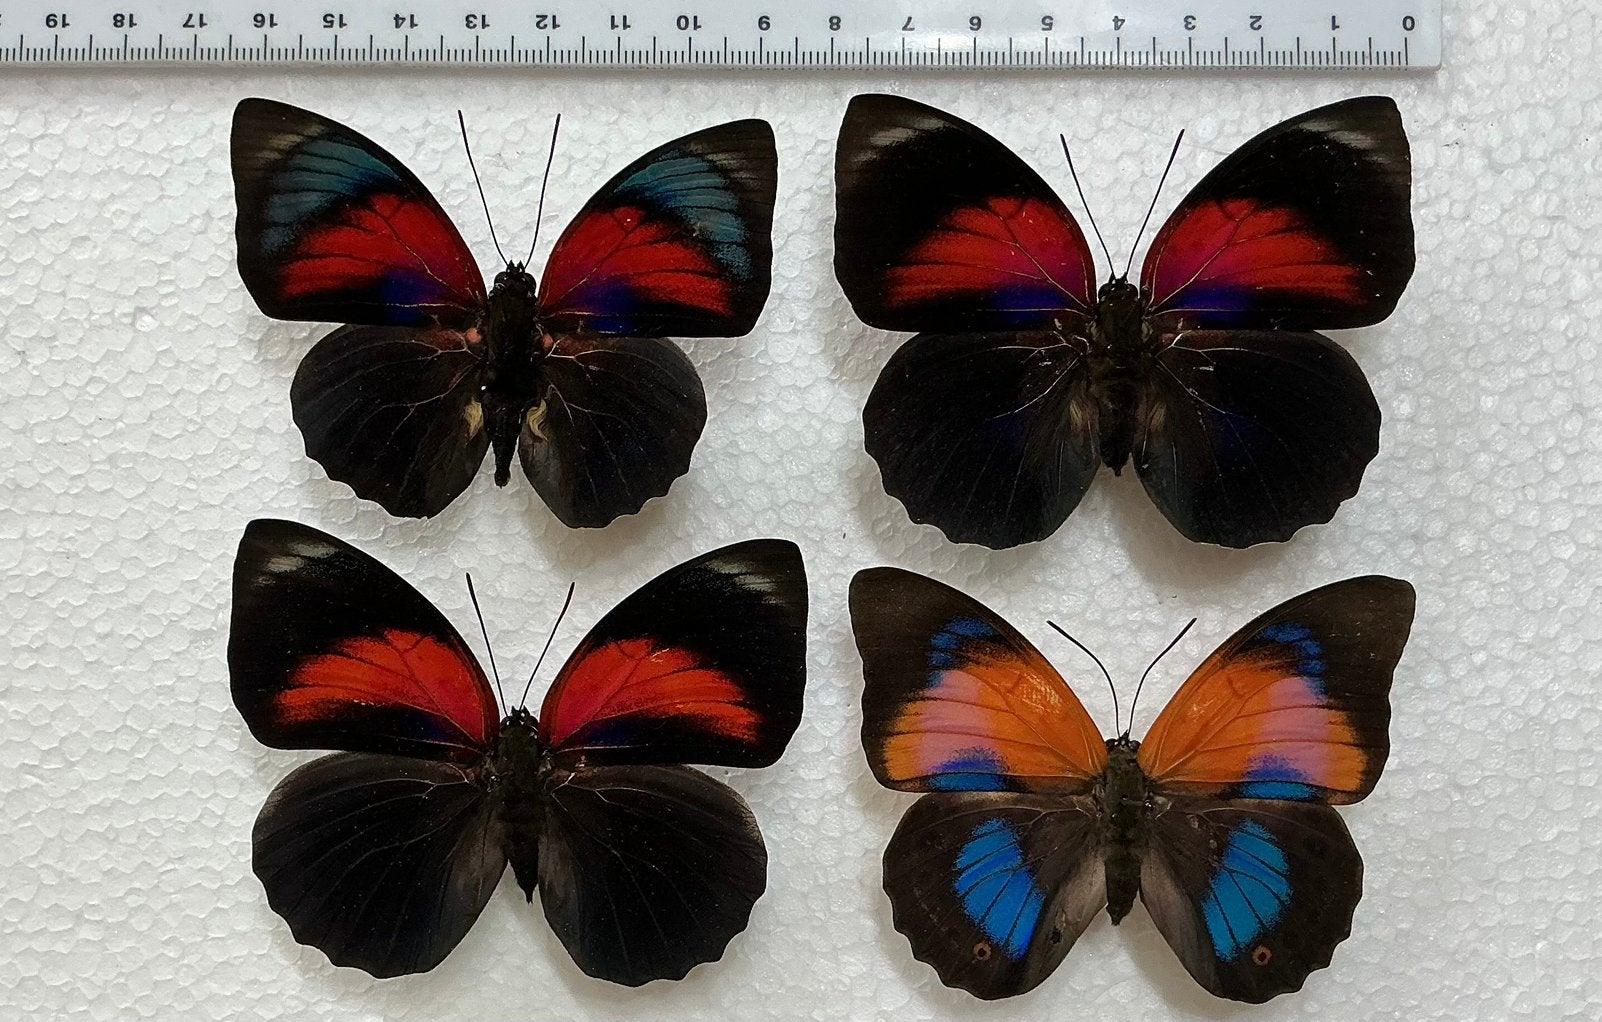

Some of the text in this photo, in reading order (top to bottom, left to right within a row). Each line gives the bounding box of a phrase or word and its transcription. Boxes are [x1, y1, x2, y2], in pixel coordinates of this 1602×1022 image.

[46, 13, 1415, 31] 0 1 2 3 4 5 6 7 8 9 10 11 12 13 14 15 16 17 18 19
